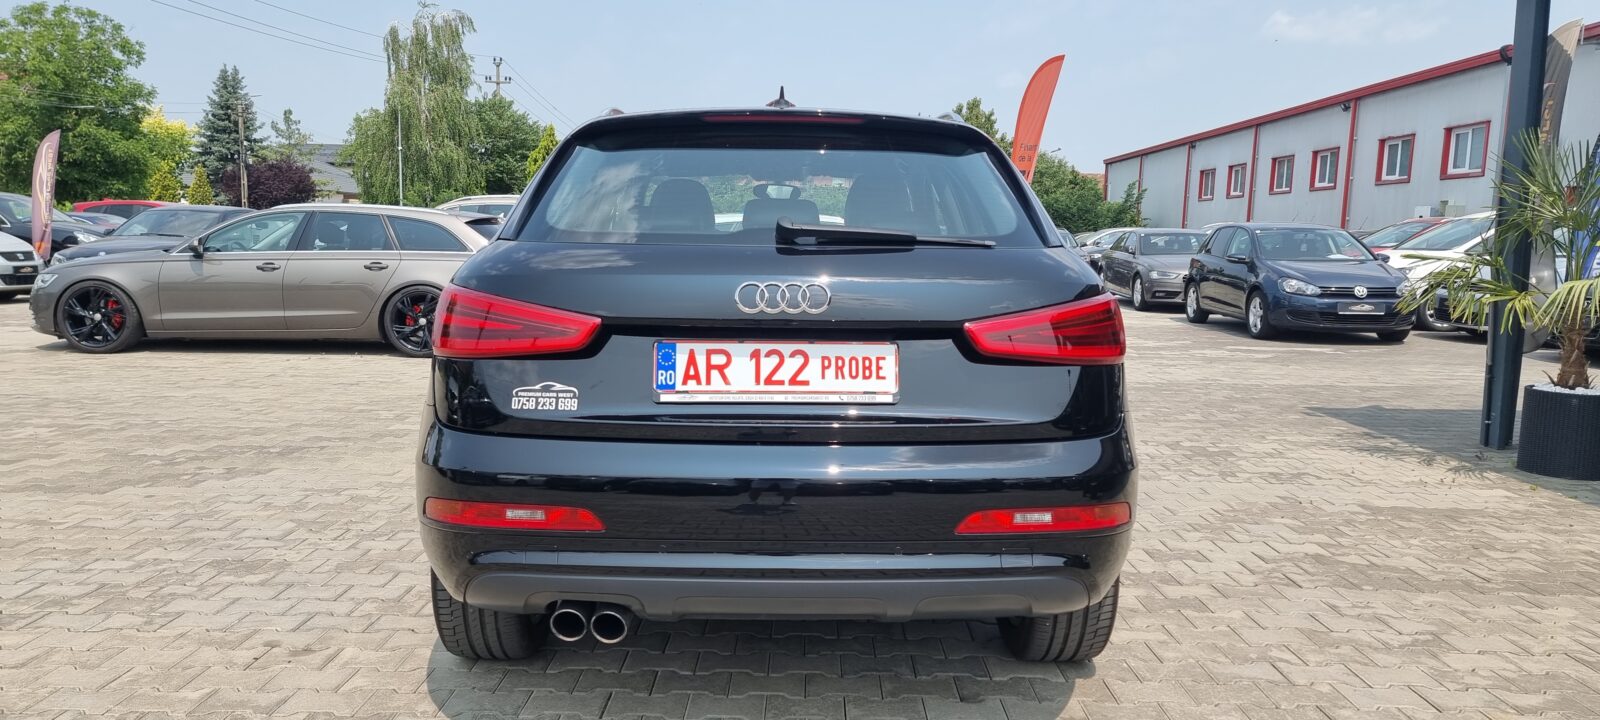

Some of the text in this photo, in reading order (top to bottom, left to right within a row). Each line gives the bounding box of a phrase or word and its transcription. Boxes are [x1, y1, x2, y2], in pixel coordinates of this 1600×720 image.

[681, 348, 887, 386] AR 122 PROBE
[658, 370, 675, 385] RO
[511, 397, 578, 411] 0758 233 699
